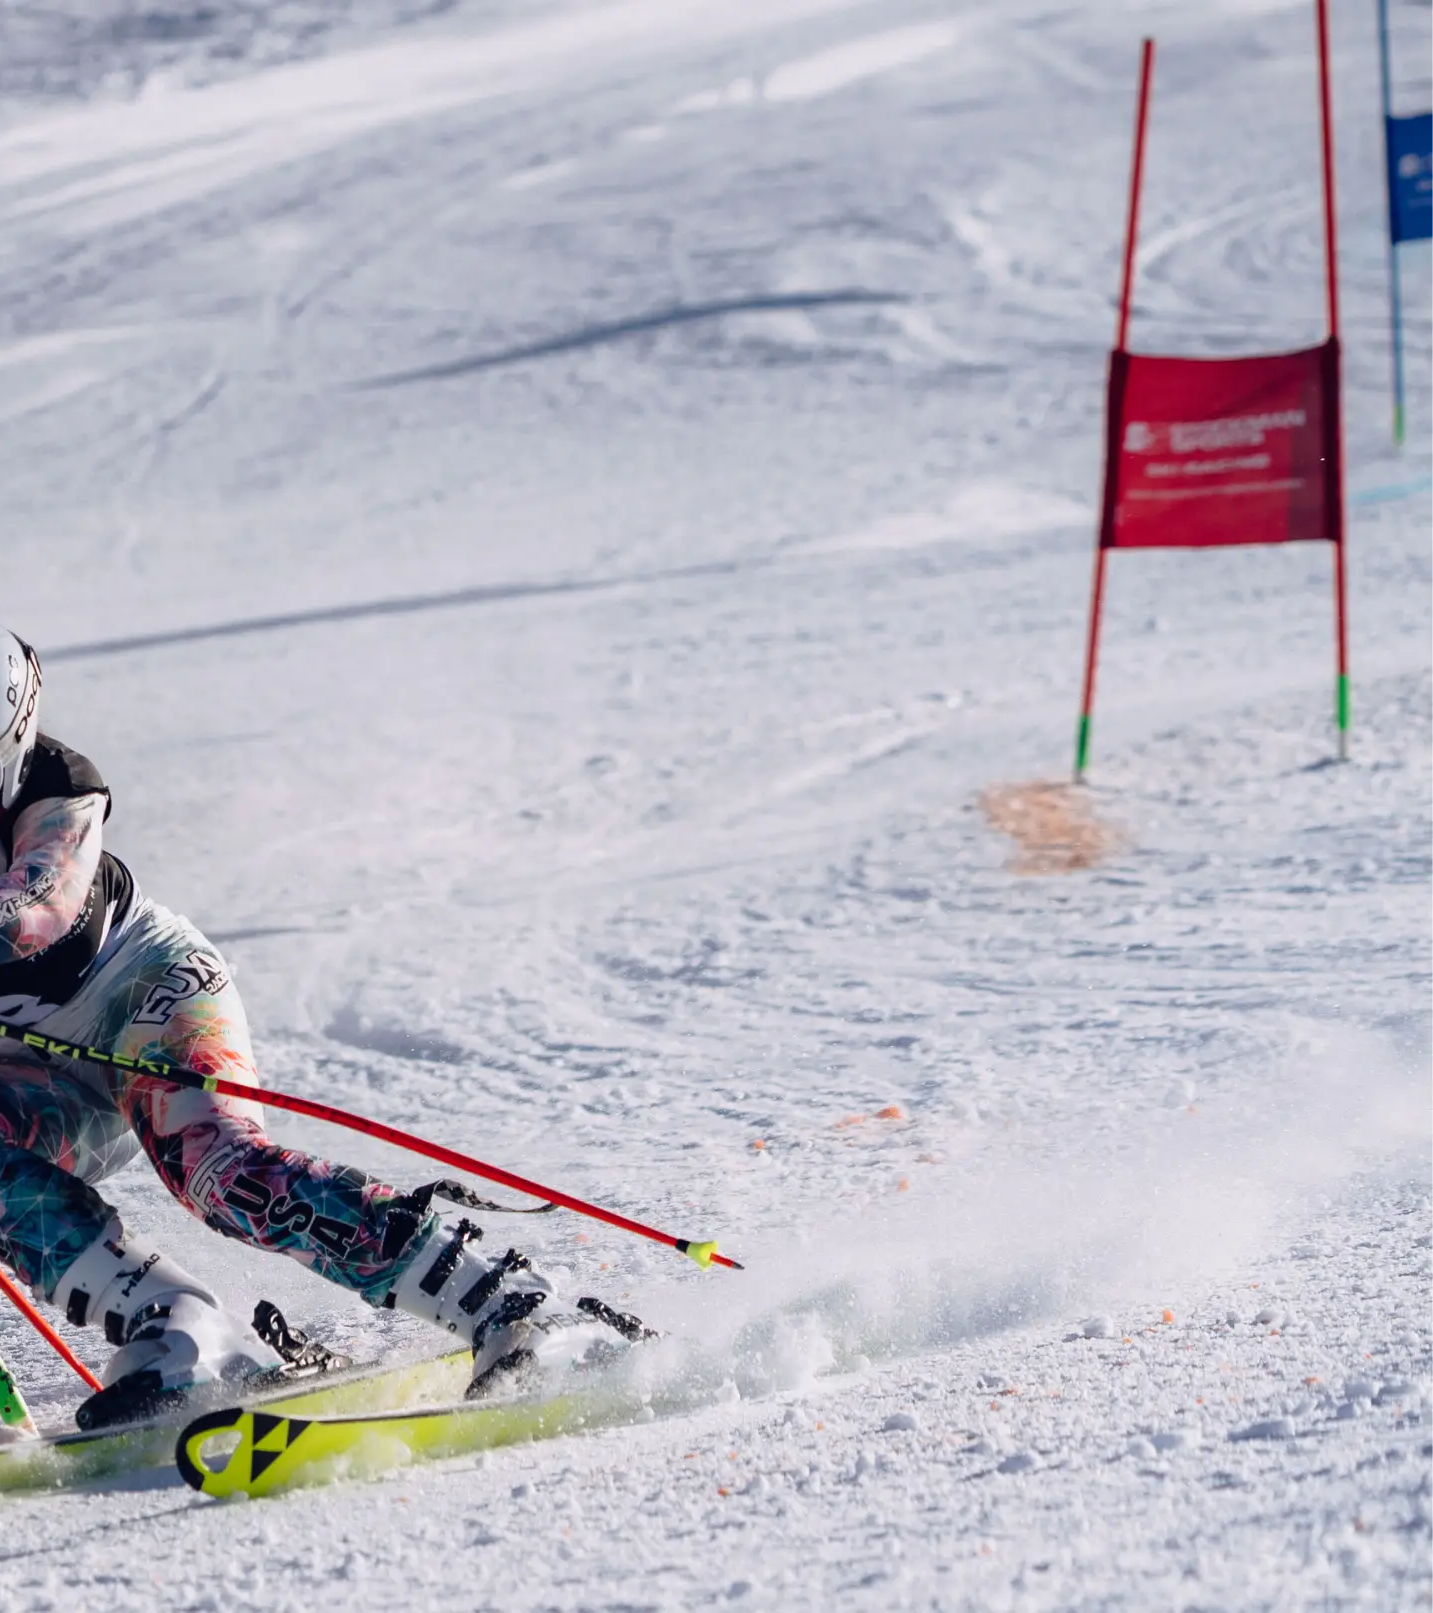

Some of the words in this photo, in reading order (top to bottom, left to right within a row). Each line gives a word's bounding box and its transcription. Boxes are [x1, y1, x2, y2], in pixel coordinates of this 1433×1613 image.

[13, 873, 55, 911] RACING
[222, 1174, 360, 1260] USA
[122, 1253, 161, 1298] HEAD
